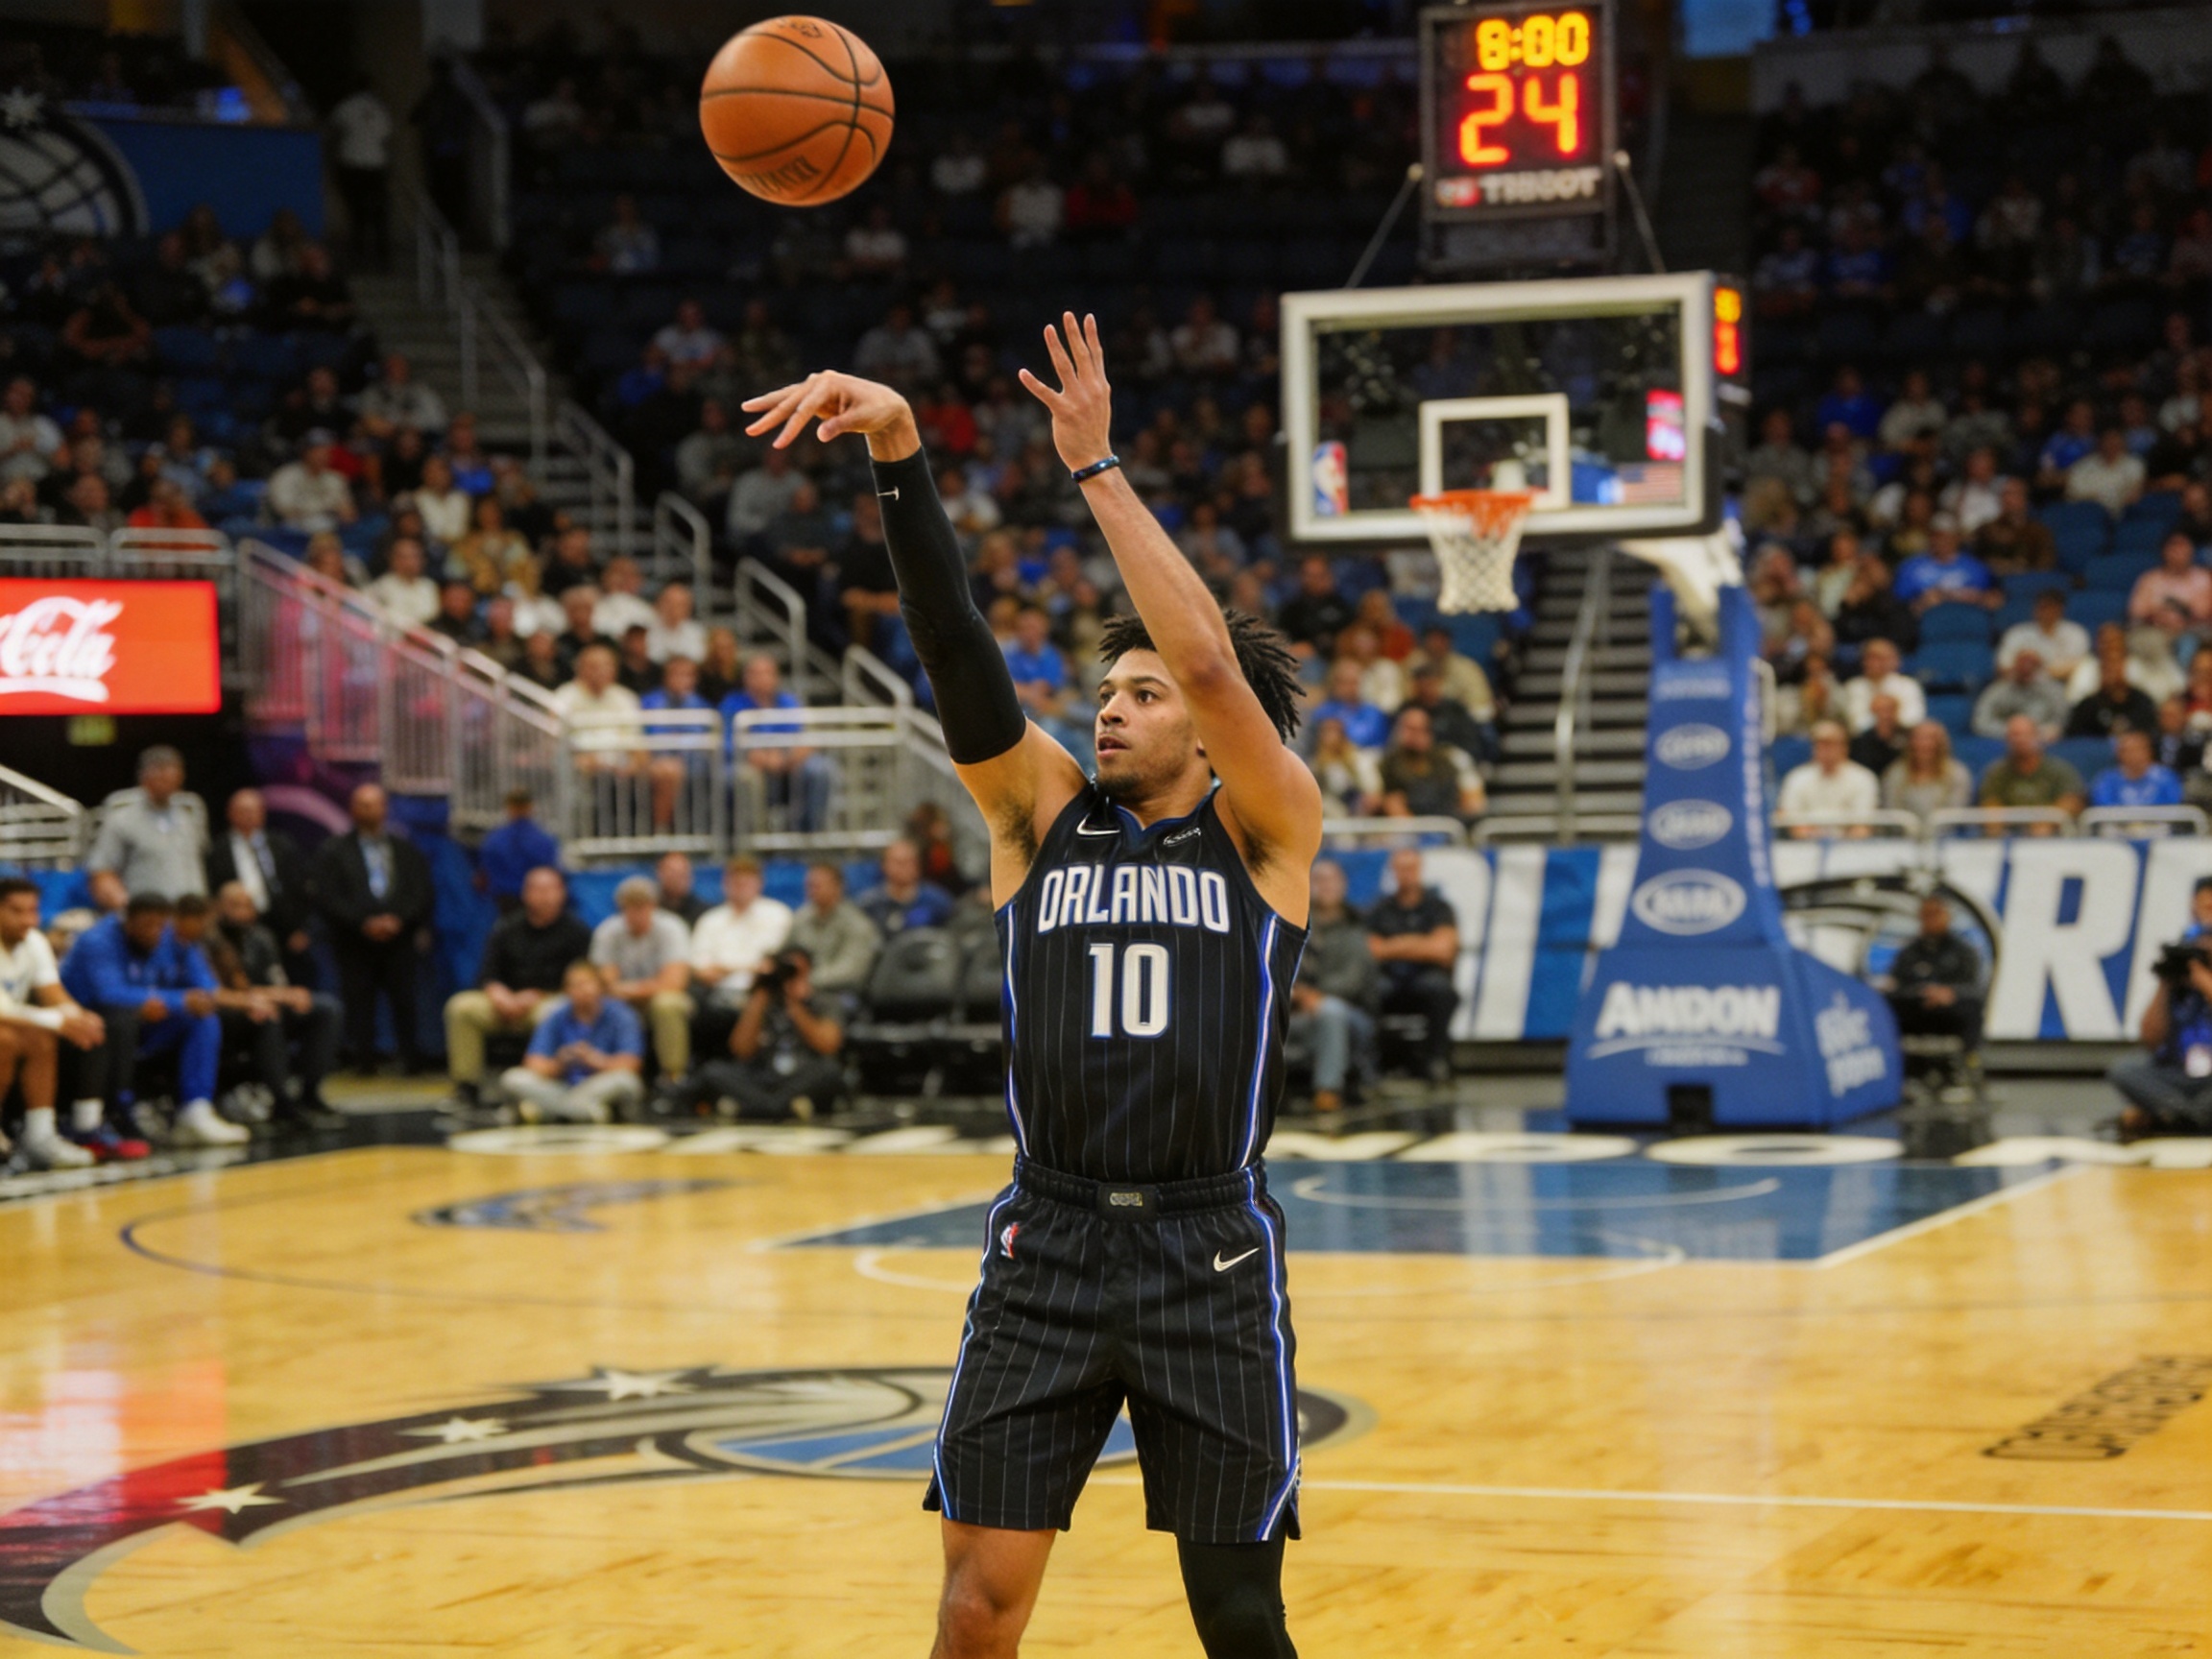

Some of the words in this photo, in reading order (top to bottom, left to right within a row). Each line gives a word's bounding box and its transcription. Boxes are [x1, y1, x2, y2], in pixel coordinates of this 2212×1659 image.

[1477, 12, 1590, 71] 8:00
[1459, 73, 1579, 166] 24
[1038, 865, 1230, 933] ORLANDO
[1089, 943, 1169, 1038] 10
